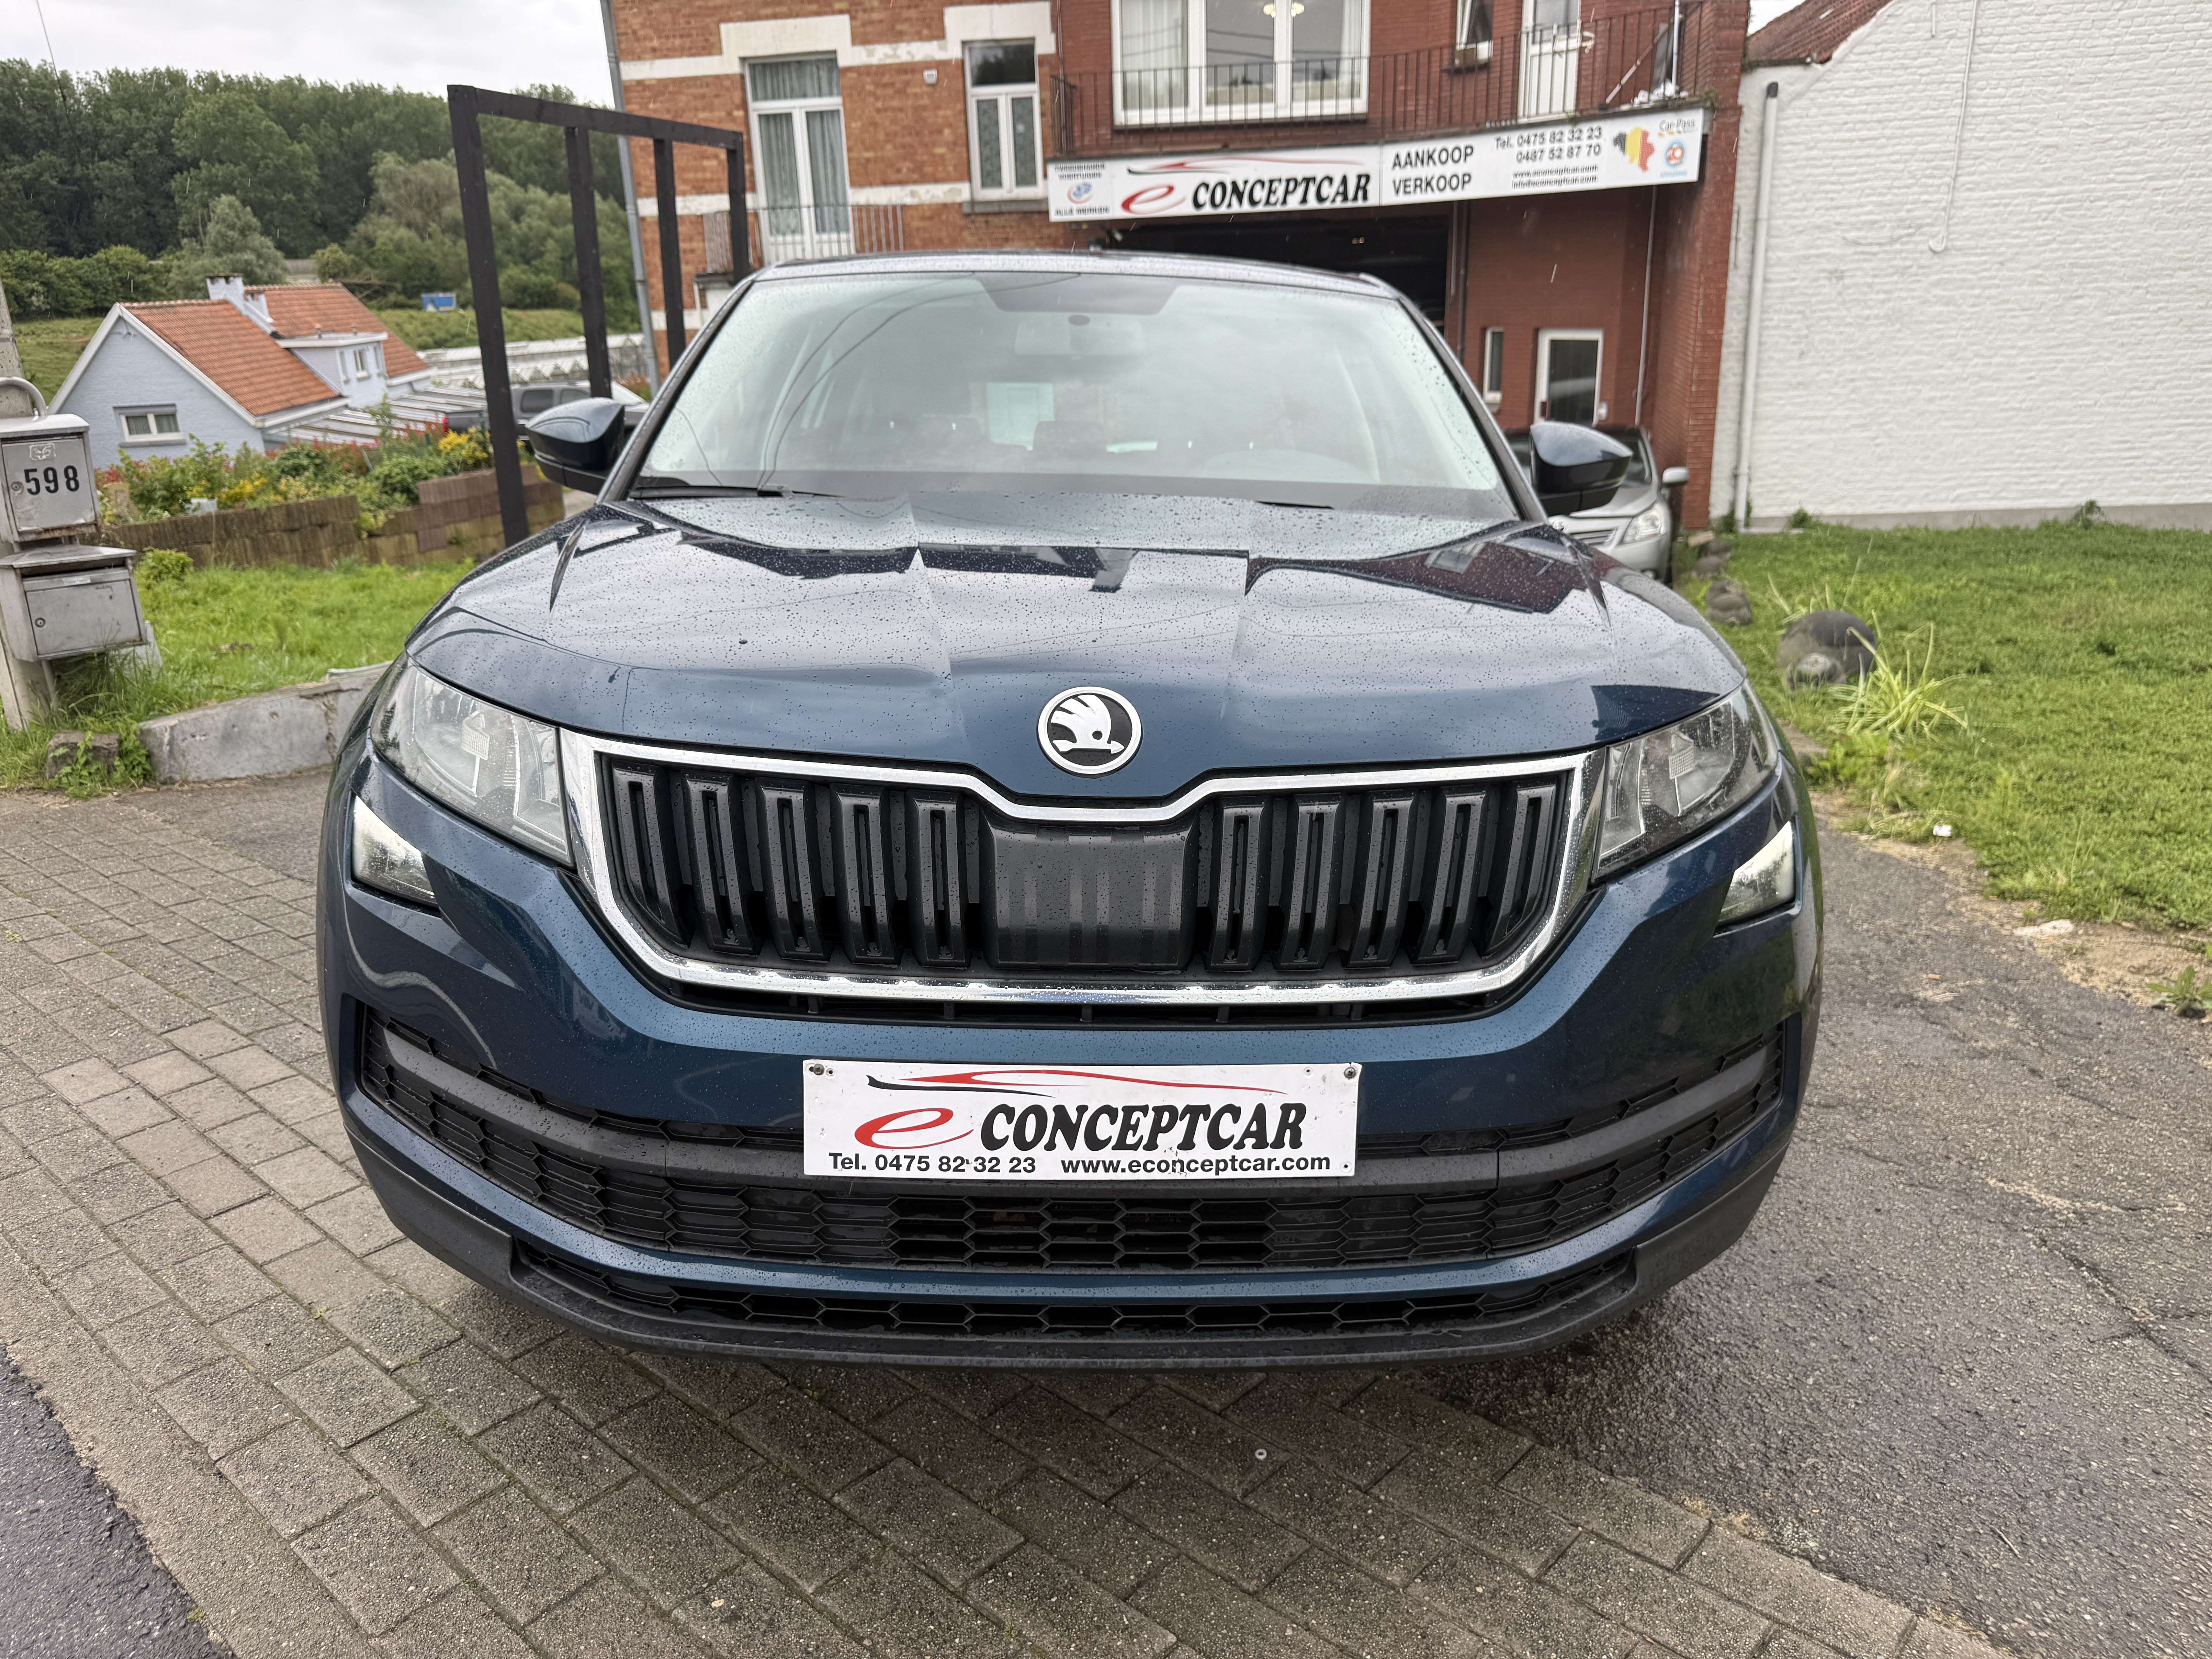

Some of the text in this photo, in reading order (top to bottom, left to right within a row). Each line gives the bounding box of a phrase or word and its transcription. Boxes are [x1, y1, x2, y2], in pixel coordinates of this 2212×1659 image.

[1496, 125, 1602, 148] Tel. 0475 82 32 23
[1392, 145, 1474, 169] AANKOOP
[1516, 143, 1601, 163] 0487 52 87 70
[1193, 173, 1370, 210] CONCEPTCAR
[1393, 173, 1472, 196] VERKOOP
[24, 465, 80, 496] 598
[980, 1103, 1307, 1152] CONCEPTCAR
[828, 1152, 1330, 1176] Tel. 0475 82 32 23 www.econceptcar.com
